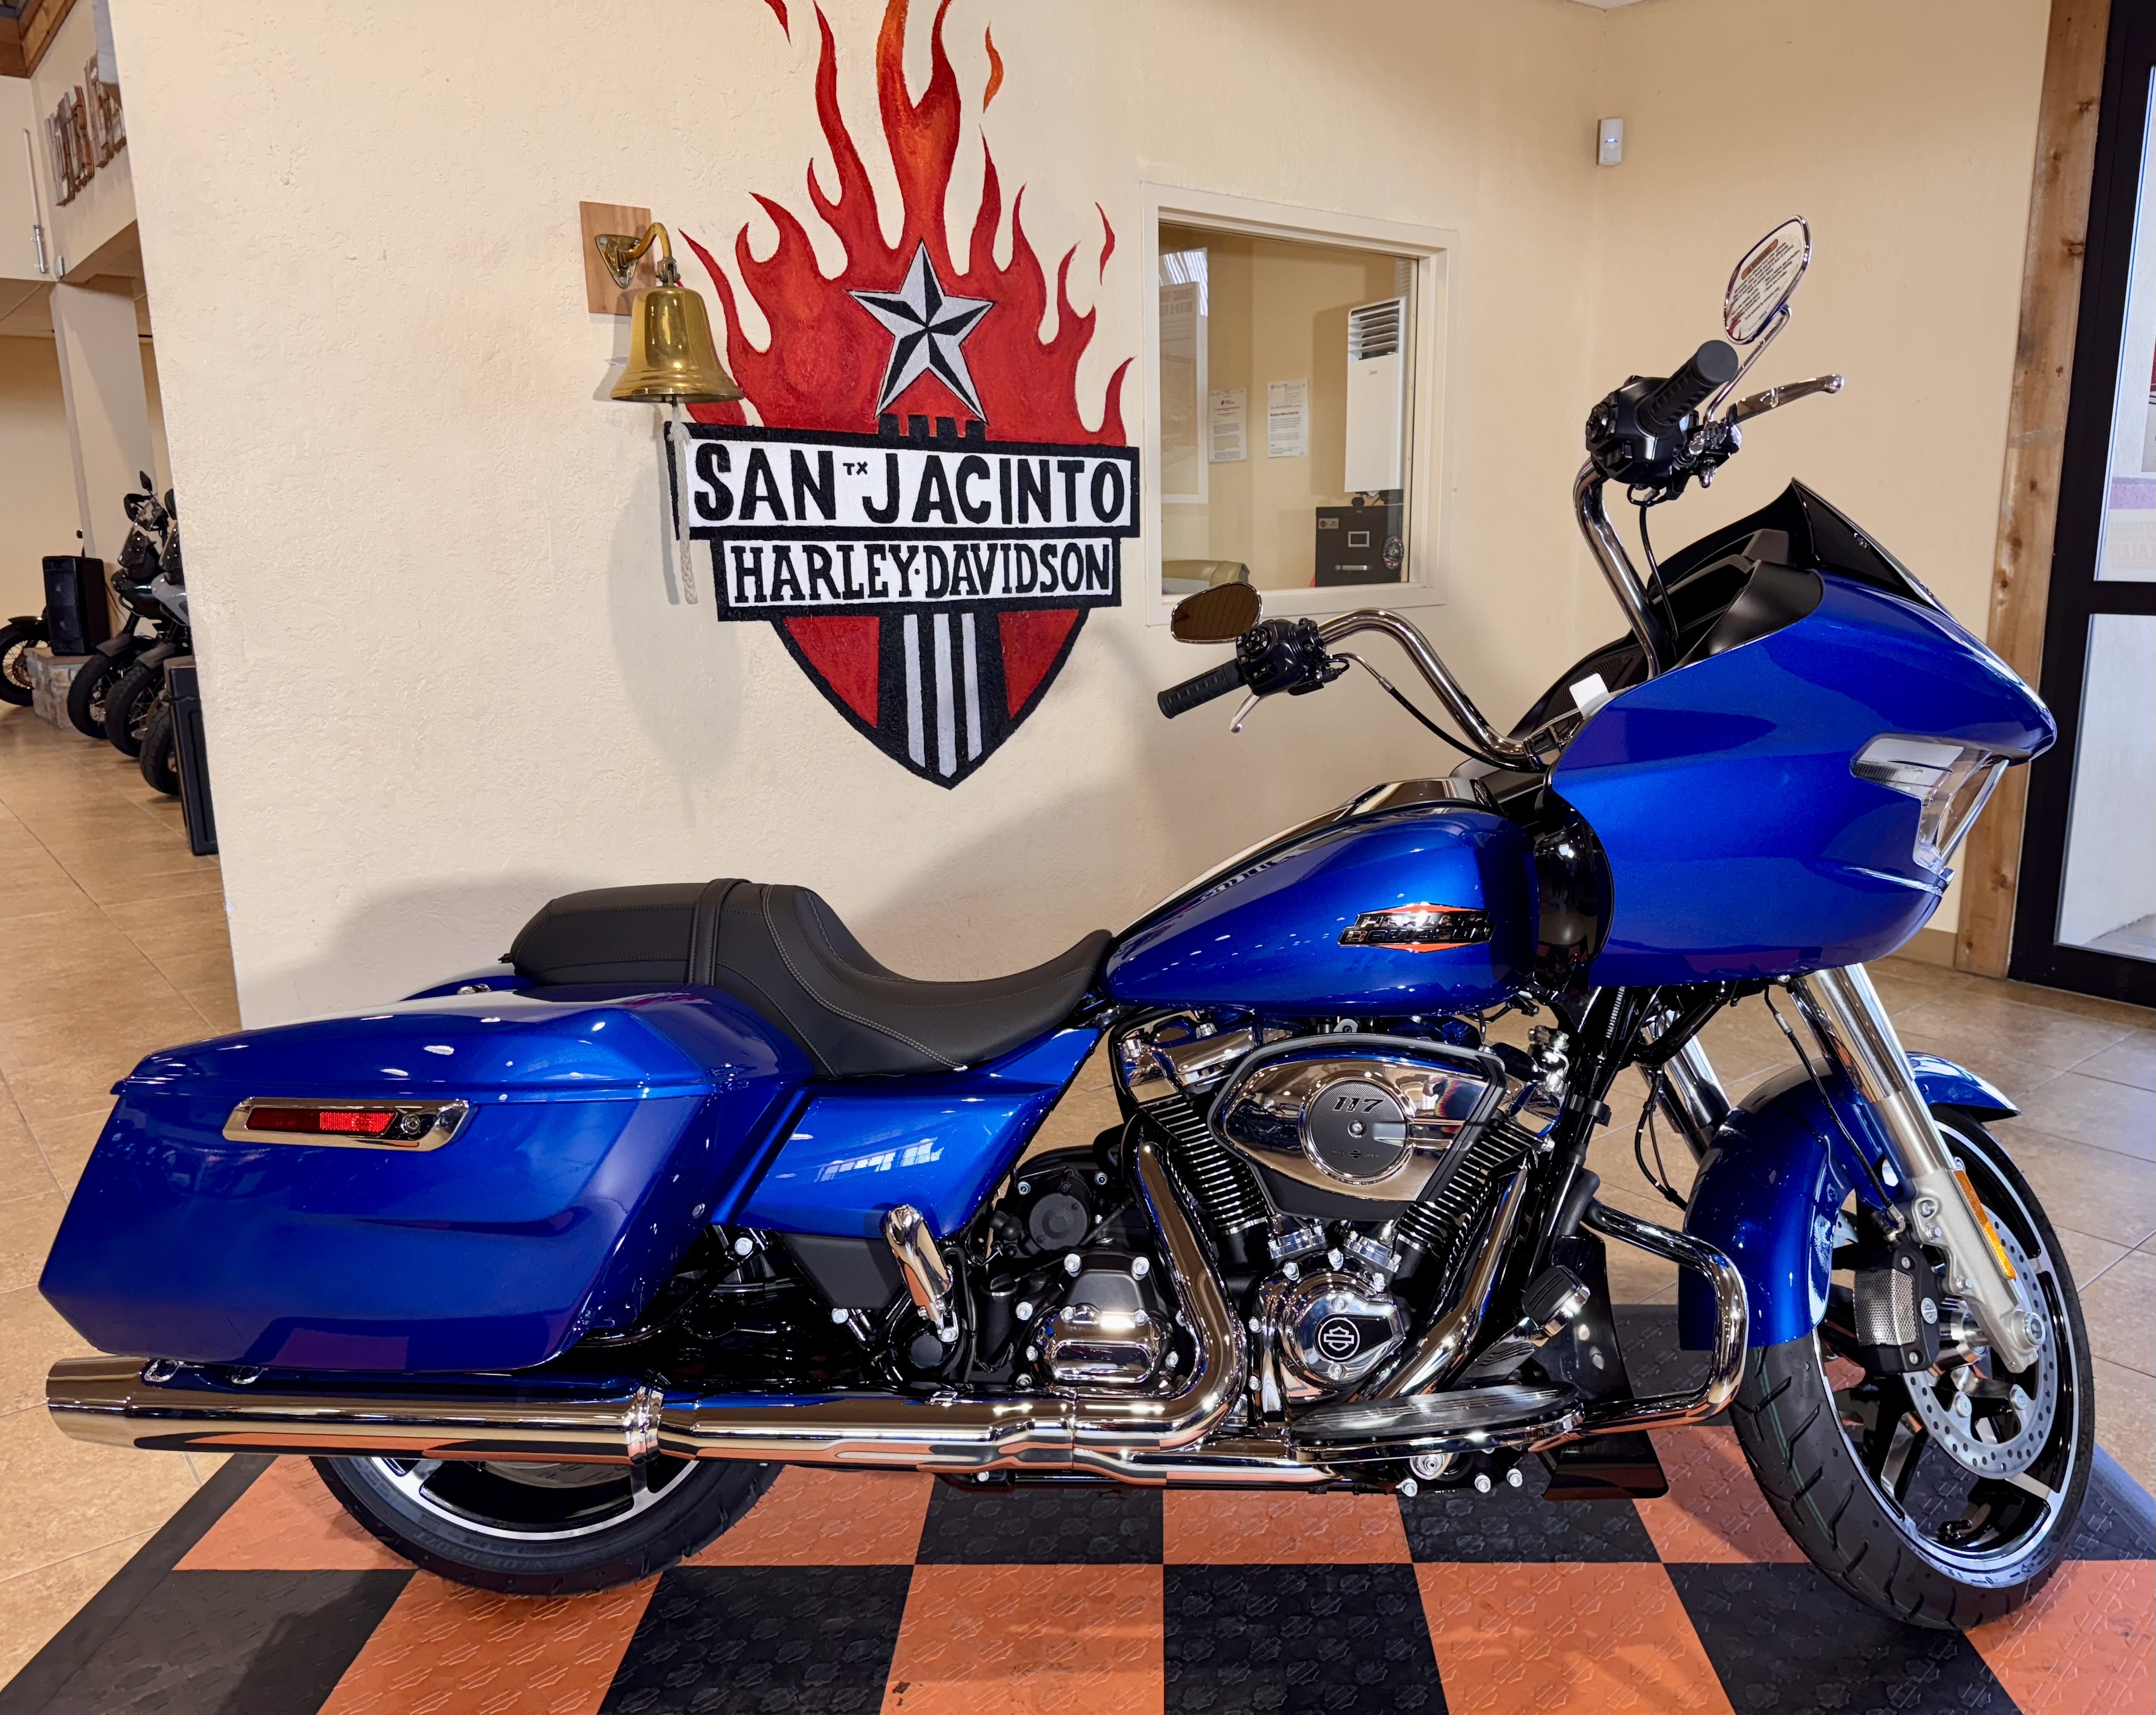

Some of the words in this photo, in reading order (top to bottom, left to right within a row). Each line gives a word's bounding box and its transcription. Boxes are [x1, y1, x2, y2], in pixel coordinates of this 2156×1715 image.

[694, 442, 837, 521] SAN
[843, 461, 868, 476] TX
[862, 452, 1125, 525] JACINTO
[1333, 1096, 1385, 1113] 117
